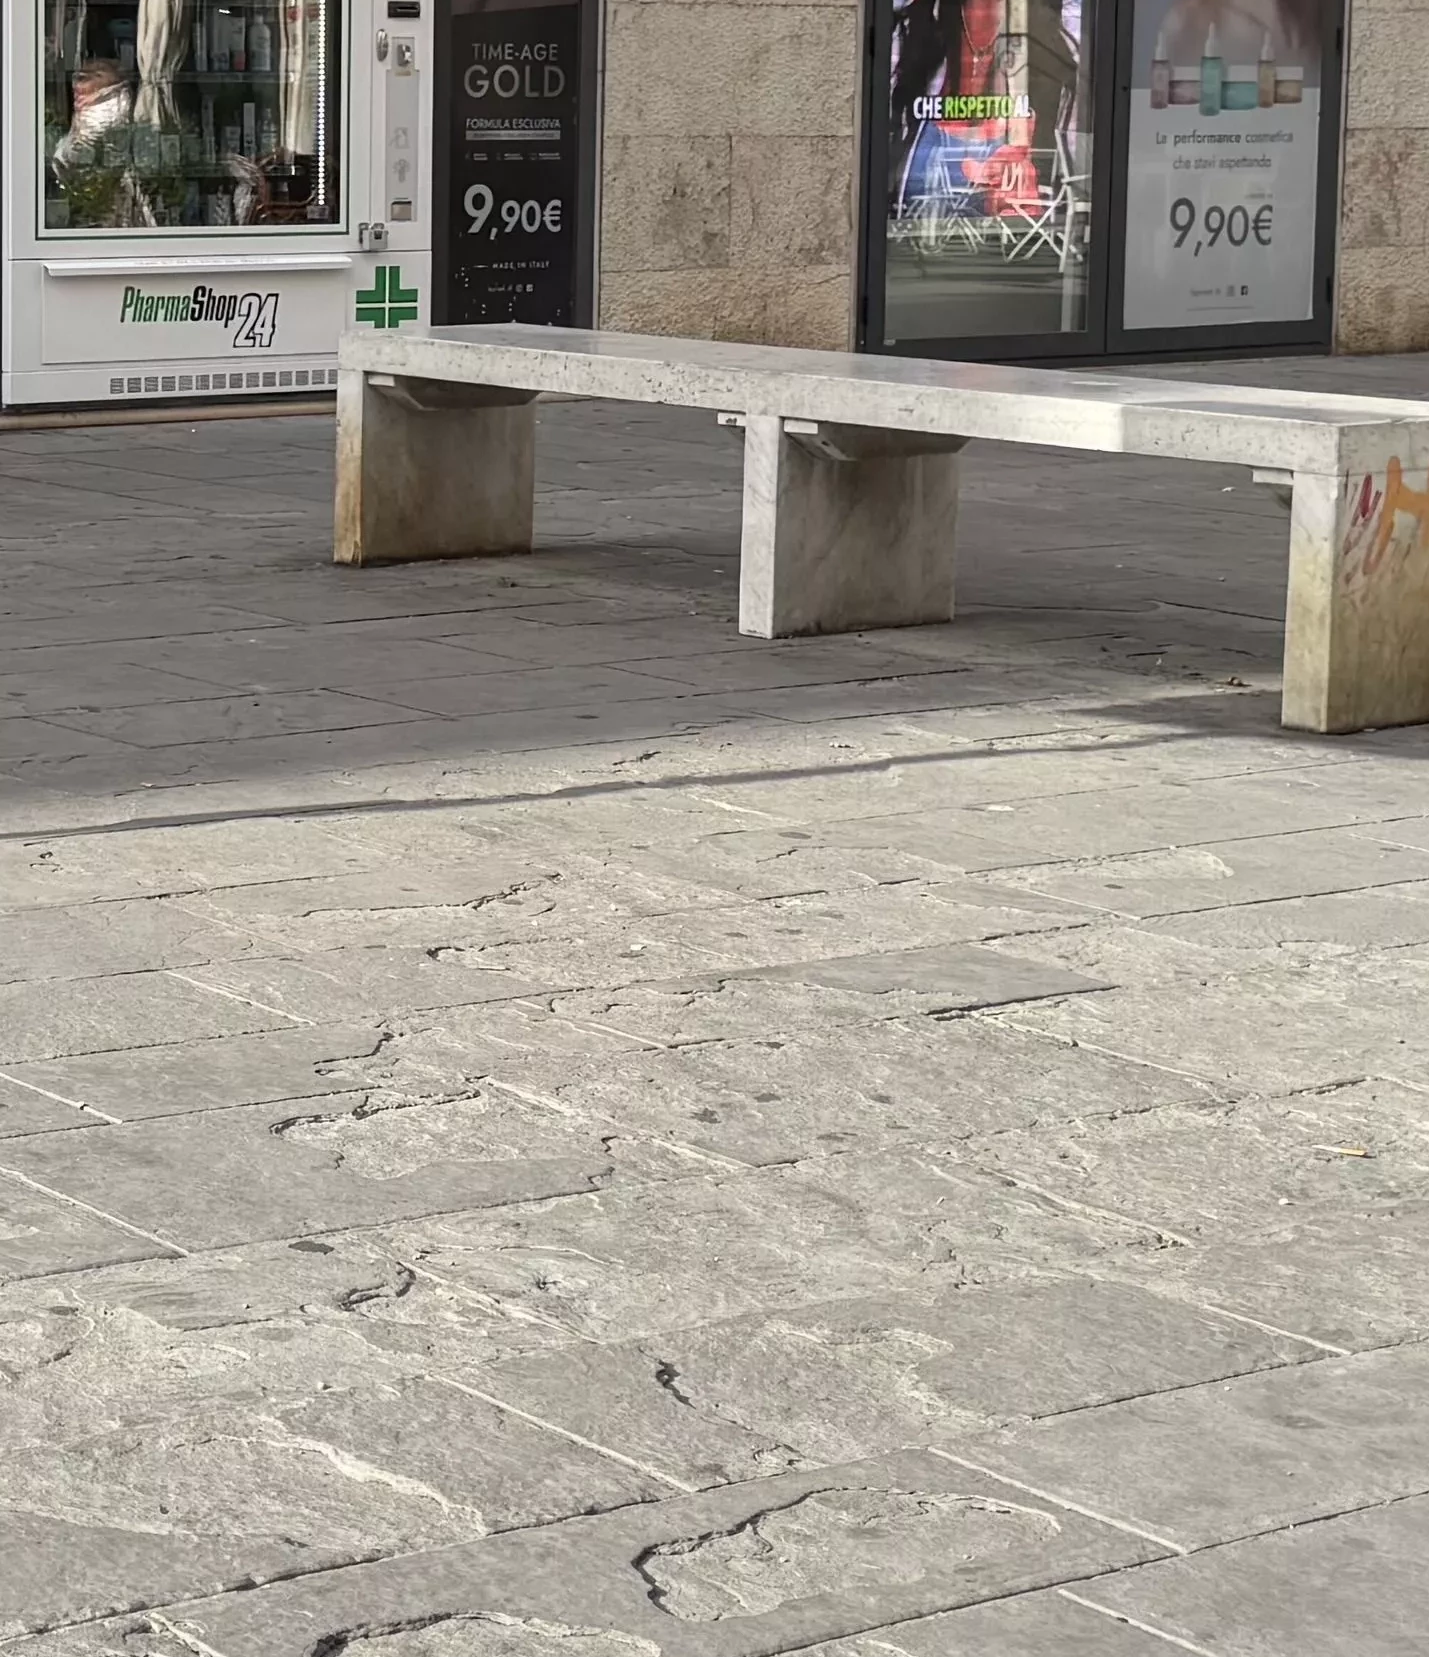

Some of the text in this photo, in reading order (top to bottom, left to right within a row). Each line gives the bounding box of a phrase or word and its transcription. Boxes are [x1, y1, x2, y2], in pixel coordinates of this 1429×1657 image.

[471, 42, 559, 61] TIME-AGE
[463, 63, 565, 98] GOLD
[913, 95, 1031, 120] CHE RISPETTO AL
[466, 117, 561, 129] FORMULA ESCLUSIVA
[1173, 129, 1242, 147] performance
[1172, 155, 1191, 170] che
[1218, 154, 1272, 171] aspettando
[463, 183, 562, 241] 9,90€
[1169, 197, 1273, 257] 9,90€
